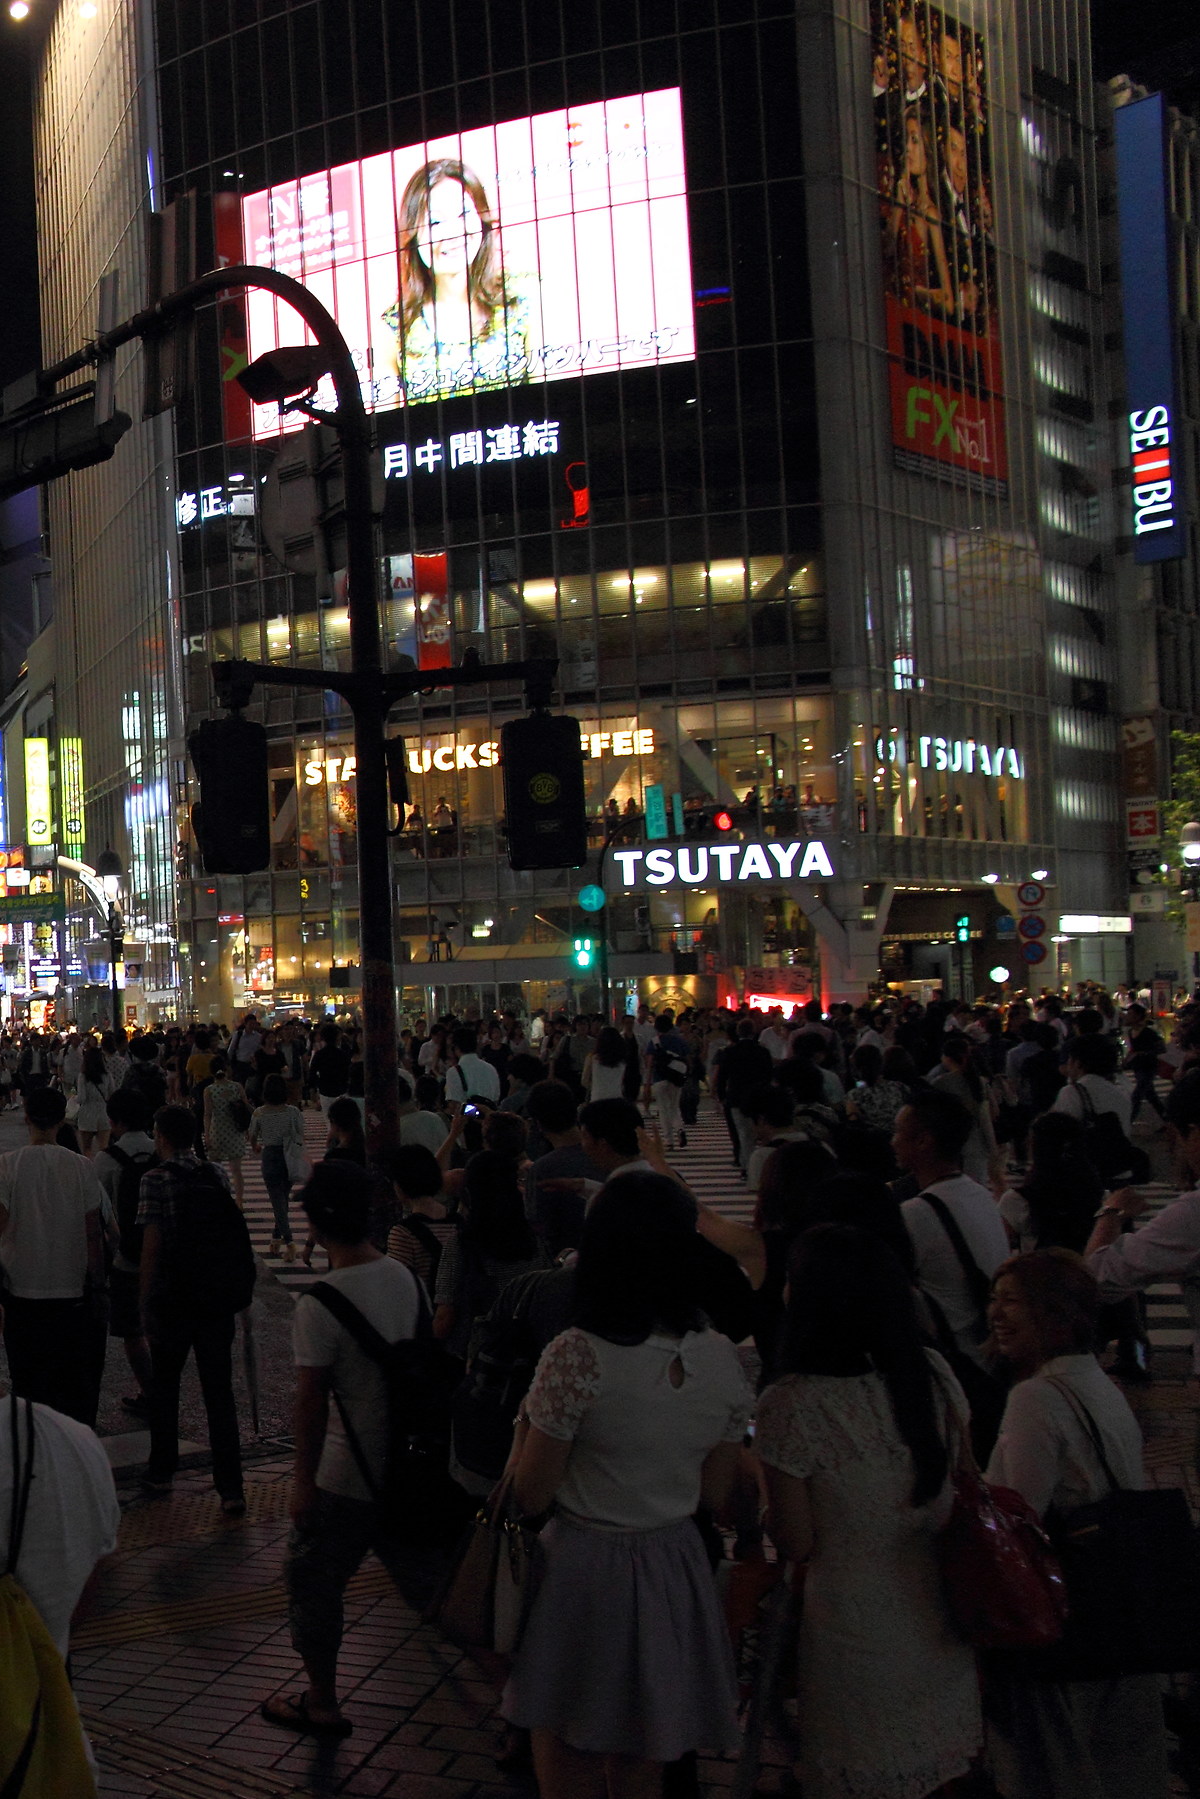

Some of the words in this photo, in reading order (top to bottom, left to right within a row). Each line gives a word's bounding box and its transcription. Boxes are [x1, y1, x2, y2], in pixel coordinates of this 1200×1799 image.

[906, 386, 962, 454] FX
[384, 419, 560, 480] 月中間連結
[1130, 405, 1174, 536] SEIBU
[305, 741, 499, 786] STAUCKS
[919, 736, 1025, 779] TSUTAYA
[613, 840, 834, 887] TSUTAYA
